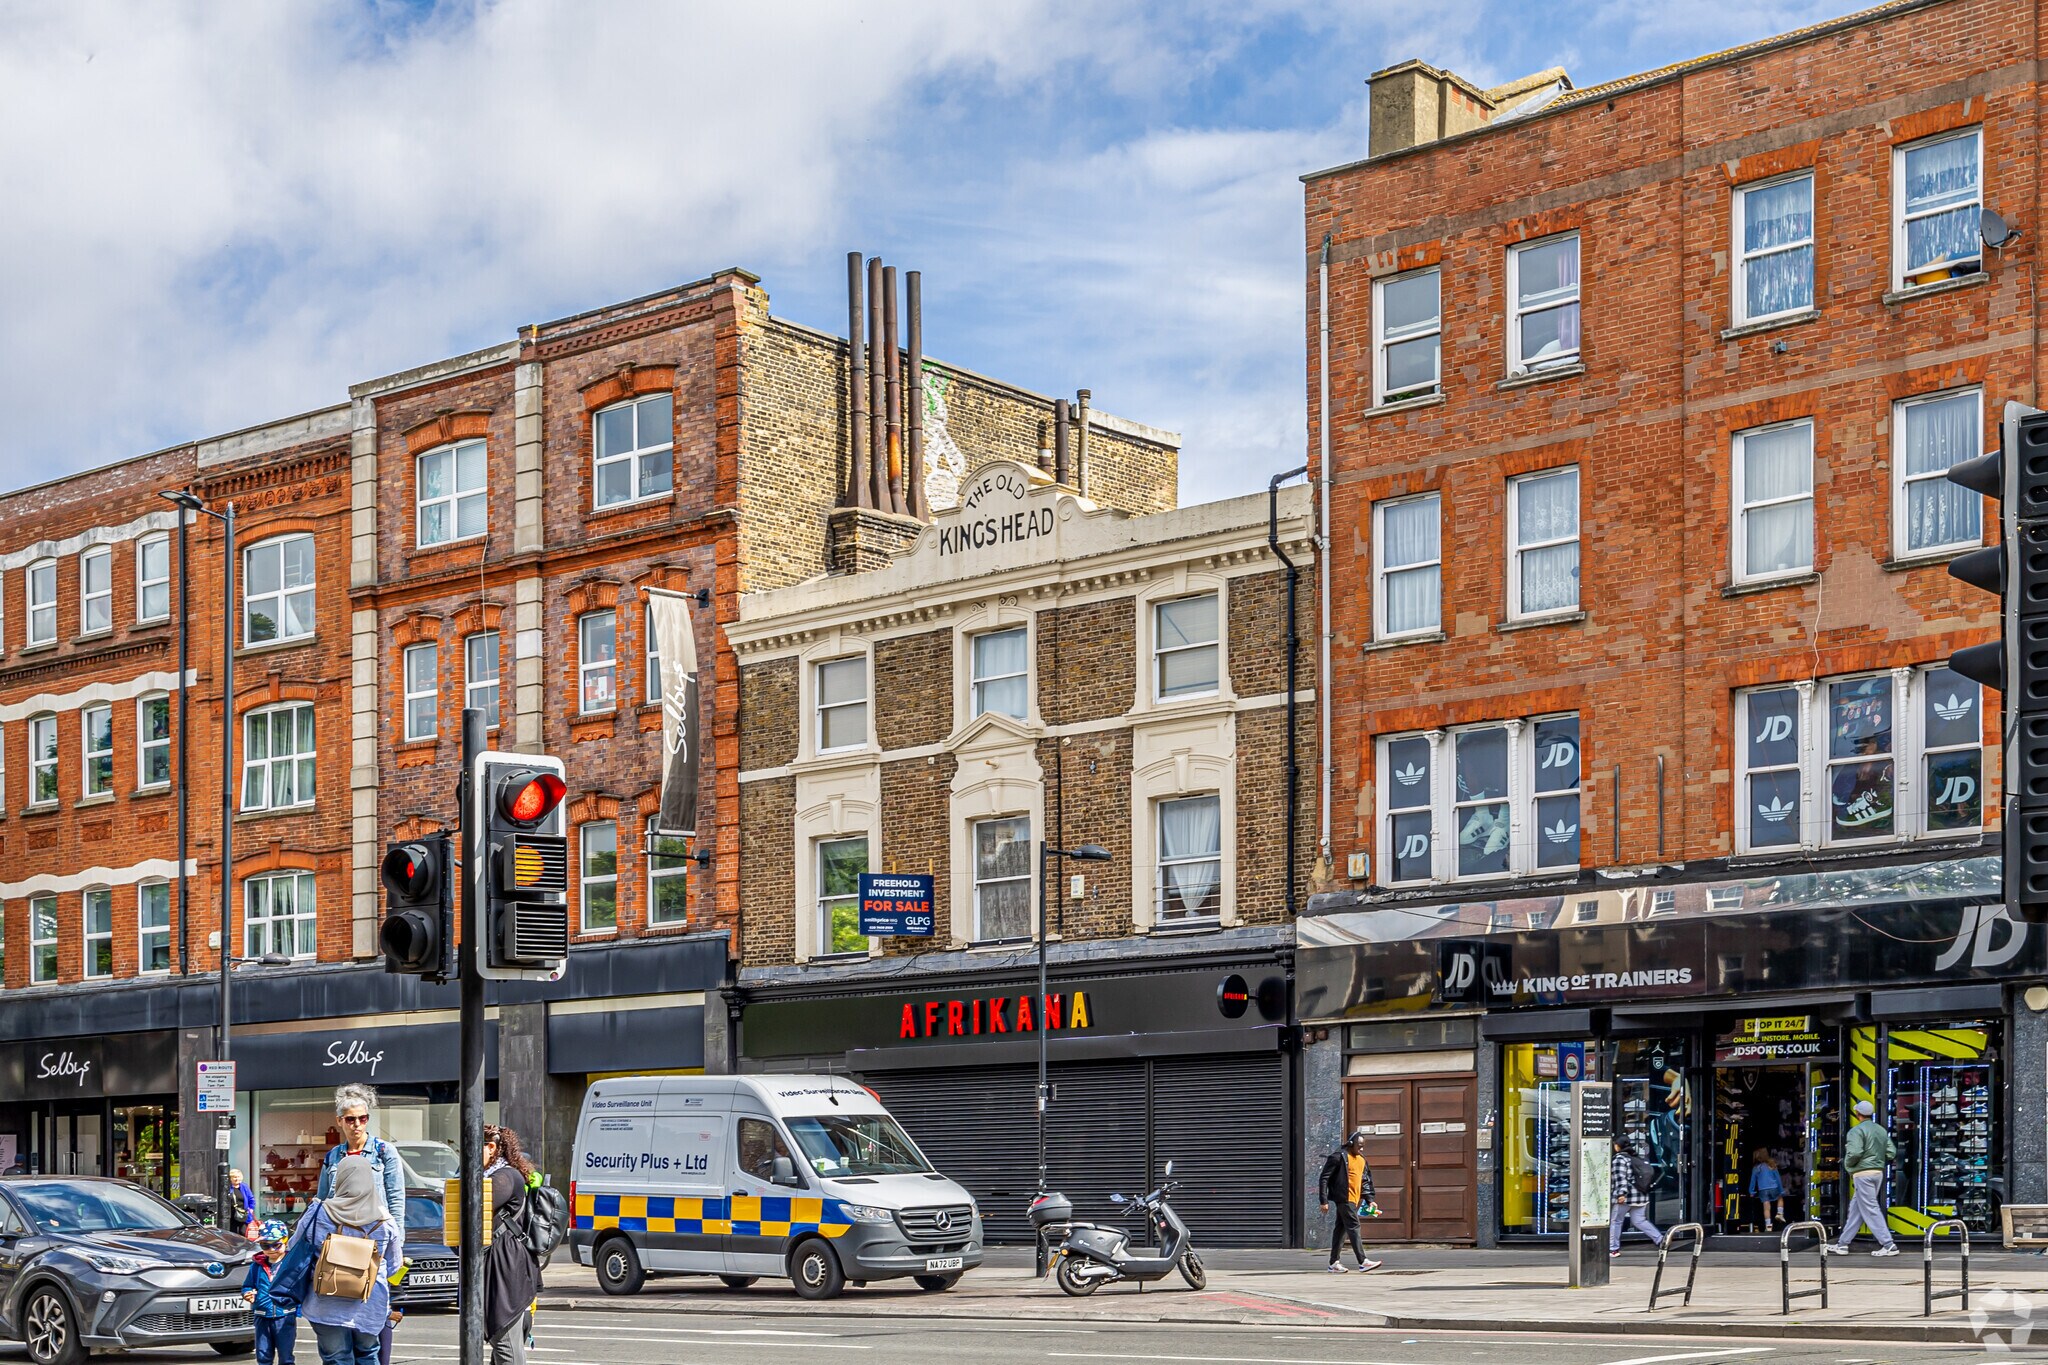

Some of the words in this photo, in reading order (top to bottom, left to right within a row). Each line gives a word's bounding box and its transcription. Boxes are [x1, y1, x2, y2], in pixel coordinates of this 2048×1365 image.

[966, 478, 992, 509] THE
[996, 474, 1025, 500] OLD
[665, 660, 696, 764] Selbys
[1756, 715, 1793, 744] JD
[1542, 742, 1575, 769] JD
[1935, 776, 1976, 805] JD
[1398, 834, 1429, 860] JD
[868, 889, 925, 898] INVESTMENT
[873, 879, 920, 888] FREEHOLD
[864, 900, 893, 912] FOR
[895, 901, 930, 912] SALE
[905, 917, 931, 926] GLPG
[1935, 904, 2028, 971] JD
[1445, 953, 1475, 988] JD
[1523, 976, 1569, 994] KING
[1571, 974, 1589, 989] OF
[1592, 968, 1692, 989] TRAINERS
[900, 991, 1093, 1038] AFRIKANA
[1747, 1021, 1772, 1030] SHOP
[1774, 1020, 1782, 1028] IT
[1785, 1020, 1805, 1028] 24/7
[1733, 1043, 1820, 1056] JDSPORTS.CO.UK
[1762, 1034, 1791, 1042] INSTORE.
[37, 1051, 91, 1086] Selbys
[322, 1040, 385, 1077] Selbys
[607, 1100, 639, 1108] Surveillance
[586, 1152, 637, 1172] Security
[641, 1153, 669, 1169] Plus
[673, 1159, 681, 1169] +
[685, 1154, 708, 1170] Ltd
[930, 1260, 947, 1268] NA72
[414, 1275, 436, 1283] VX64
[439, 1274, 455, 1282] TXL
[197, 1299, 221, 1311] EA71
[224, 1298, 244, 1309] PNZ
